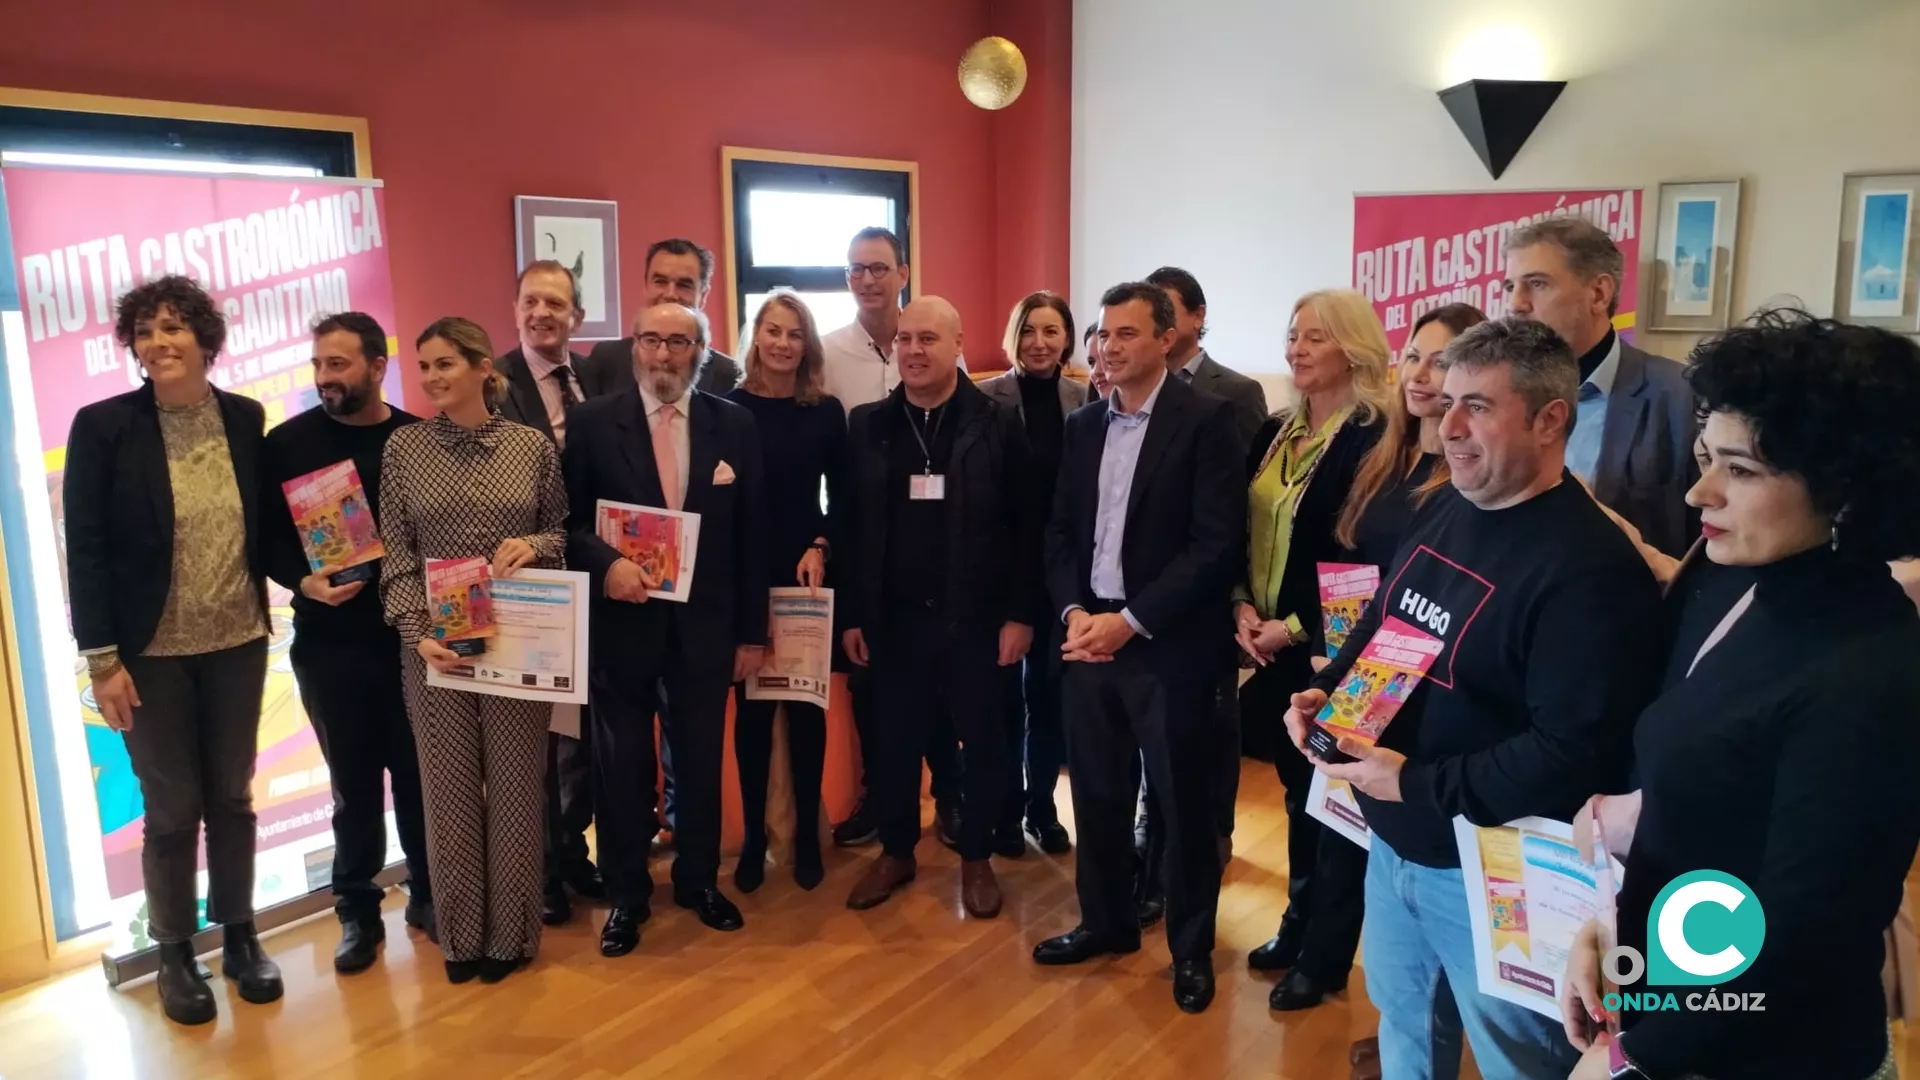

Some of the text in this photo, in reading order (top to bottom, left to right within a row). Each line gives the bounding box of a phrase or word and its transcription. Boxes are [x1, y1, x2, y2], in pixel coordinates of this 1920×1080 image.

[1356, 236, 1427, 304] RUTA
[1432, 189, 1636, 288] GASTRICA
[22, 234, 134, 343] RUTA
[1385, 303, 1407, 332] DEL
[83, 333, 121, 378] DEL
[1400, 588, 1451, 636] HUGO
[313, 807, 325, 822] de
